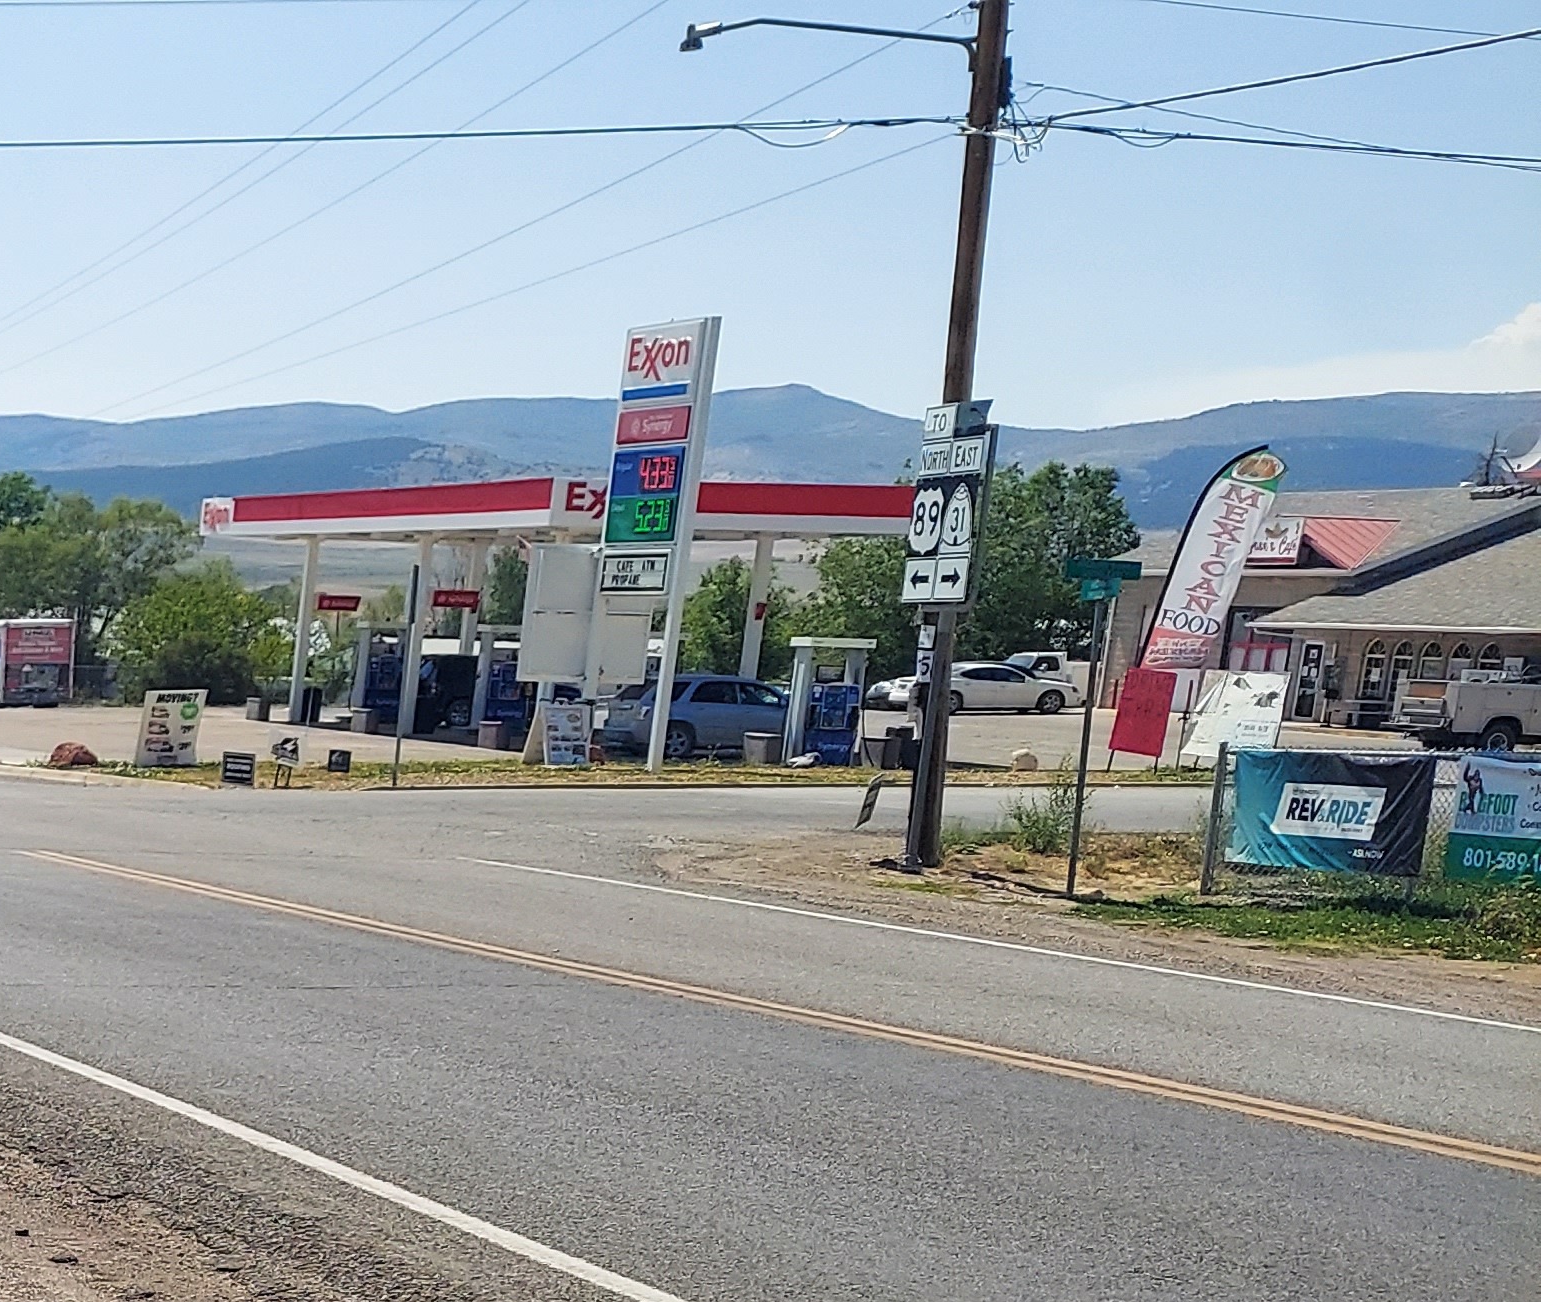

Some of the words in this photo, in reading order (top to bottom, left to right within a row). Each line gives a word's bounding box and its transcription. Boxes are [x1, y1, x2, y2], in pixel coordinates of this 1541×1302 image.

[627, 337, 690, 381] Exxon
[933, 413, 947, 433] TO
[922, 449, 948, 472] NORTH
[953, 446, 978, 468] EAST
[914, 501, 940, 536] 89
[950, 506, 966, 533] 31
[1181, 484, 1265, 614] MEXICAN
[1158, 609, 1221, 635] FOOD
[156, 693, 199, 704] MOVING?
[1459, 791, 1519, 815] BGFOOT
[1463, 847, 1541, 873] 801-589-1
